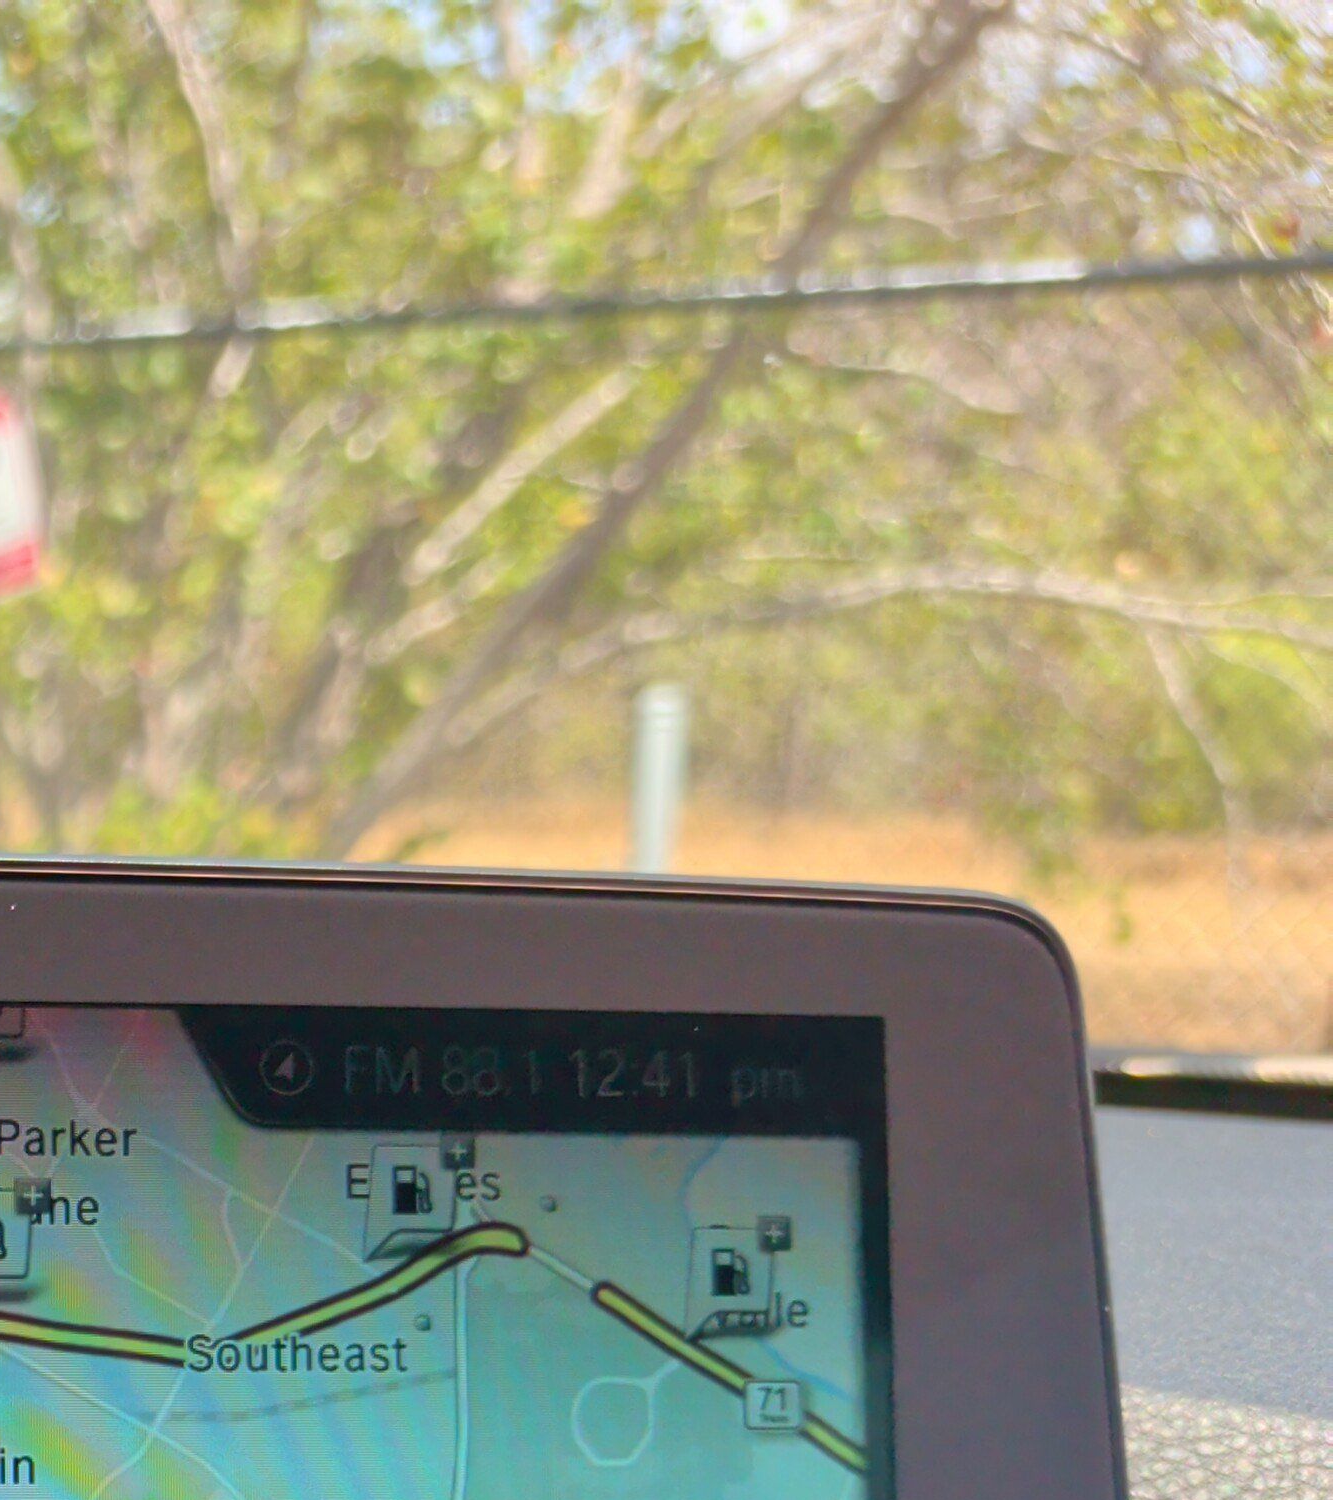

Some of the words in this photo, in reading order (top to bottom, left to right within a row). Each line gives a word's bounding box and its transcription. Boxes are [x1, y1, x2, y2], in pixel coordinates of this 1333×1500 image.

[343, 1043, 422, 1095] FM
[187, 1335, 408, 1374] Southeast
[757, 1386, 788, 1412] 71
